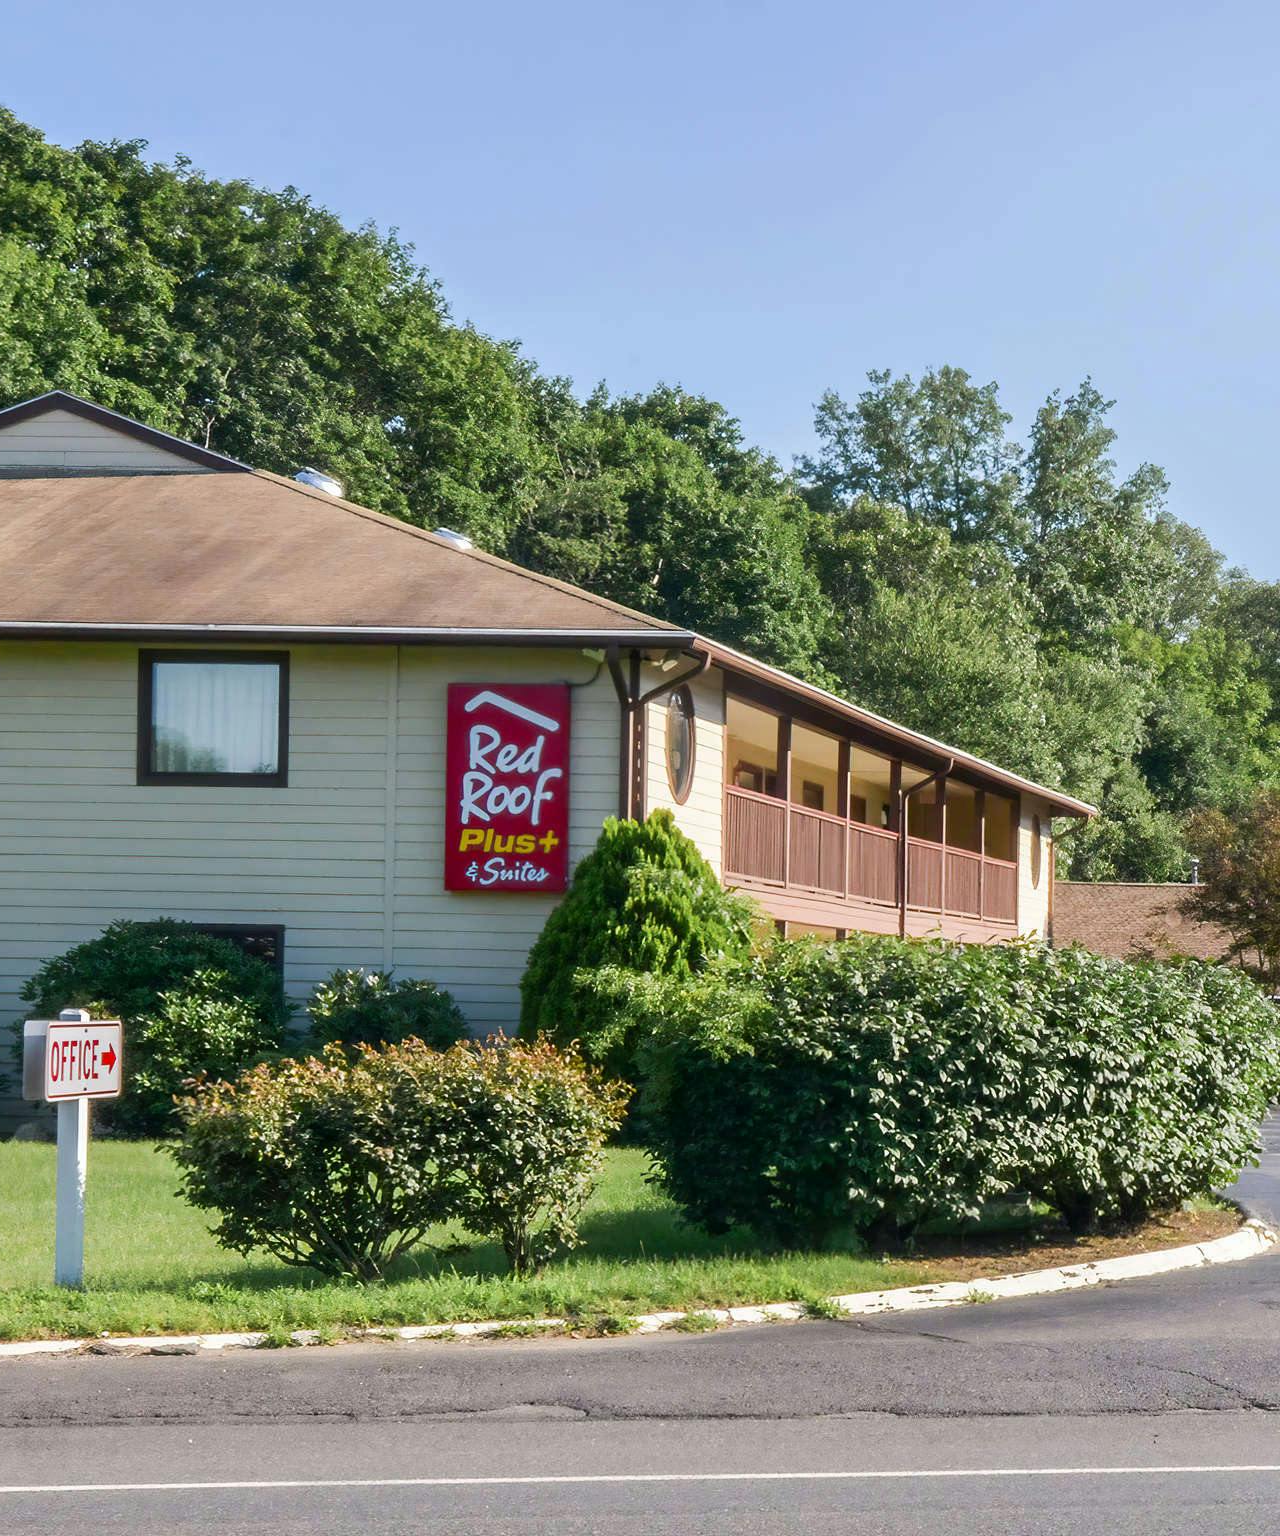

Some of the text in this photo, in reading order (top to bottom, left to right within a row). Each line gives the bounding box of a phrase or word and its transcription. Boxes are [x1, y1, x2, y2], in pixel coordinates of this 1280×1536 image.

[469, 724, 545, 775] Red
[459, 768, 563, 827] Roof
[458, 828, 560, 854] Plus+
[479, 857, 549, 885] Suites
[51, 1039, 99, 1082] OFFICE
